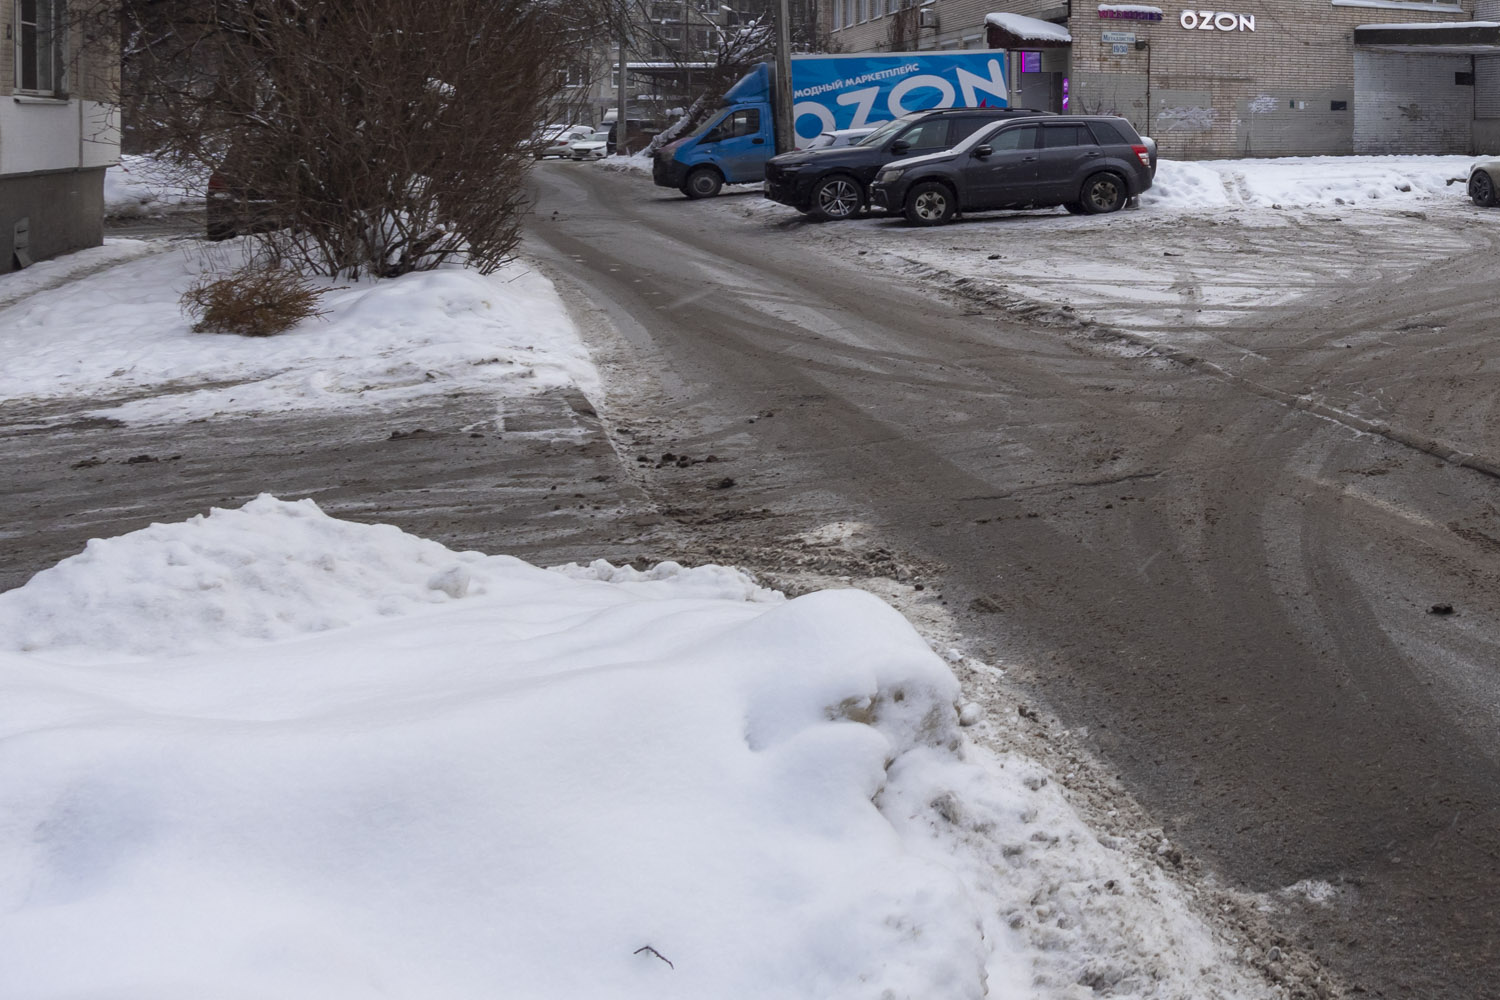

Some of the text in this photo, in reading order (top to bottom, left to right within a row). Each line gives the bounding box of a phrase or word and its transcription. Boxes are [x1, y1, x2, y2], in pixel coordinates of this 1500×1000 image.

[1180, 11, 1255, 32] OZON
[845, 63, 920, 87] МАРКЕТПЛЕЙС
[794, 59, 1007, 150] OZON
